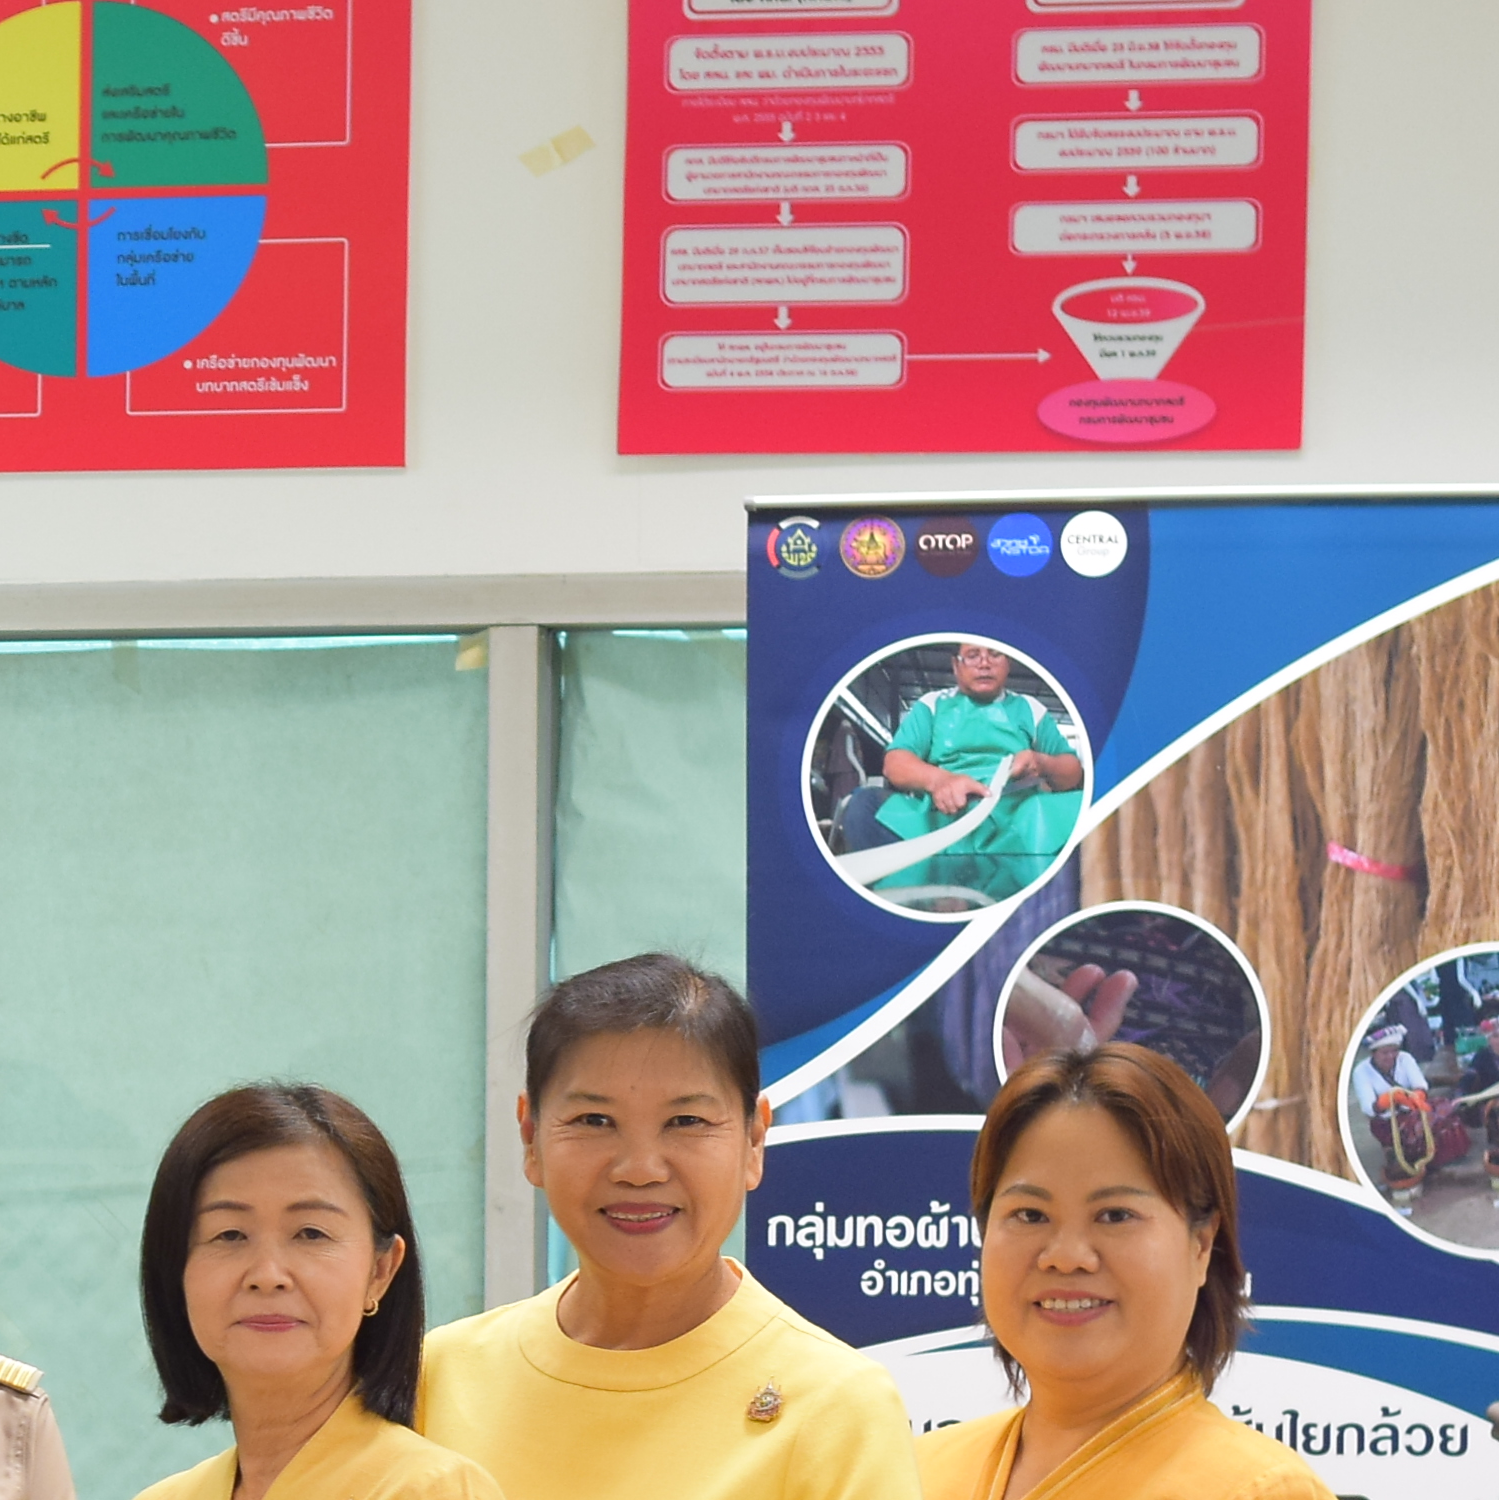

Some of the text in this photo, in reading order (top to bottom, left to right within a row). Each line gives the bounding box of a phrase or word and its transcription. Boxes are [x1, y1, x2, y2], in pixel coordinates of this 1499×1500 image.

[220, 6, 334, 25] สตรีมีคุณภาพชีวิต
[195, 353, 337, 372] เครือข่ายกองทุนพัฒนา
[195, 374, 309, 393] บทบาทสตรีเข้มแข็ง
[918, 532, 974, 551] OTOP
[1067, 533, 1120, 546] CENTRAL
